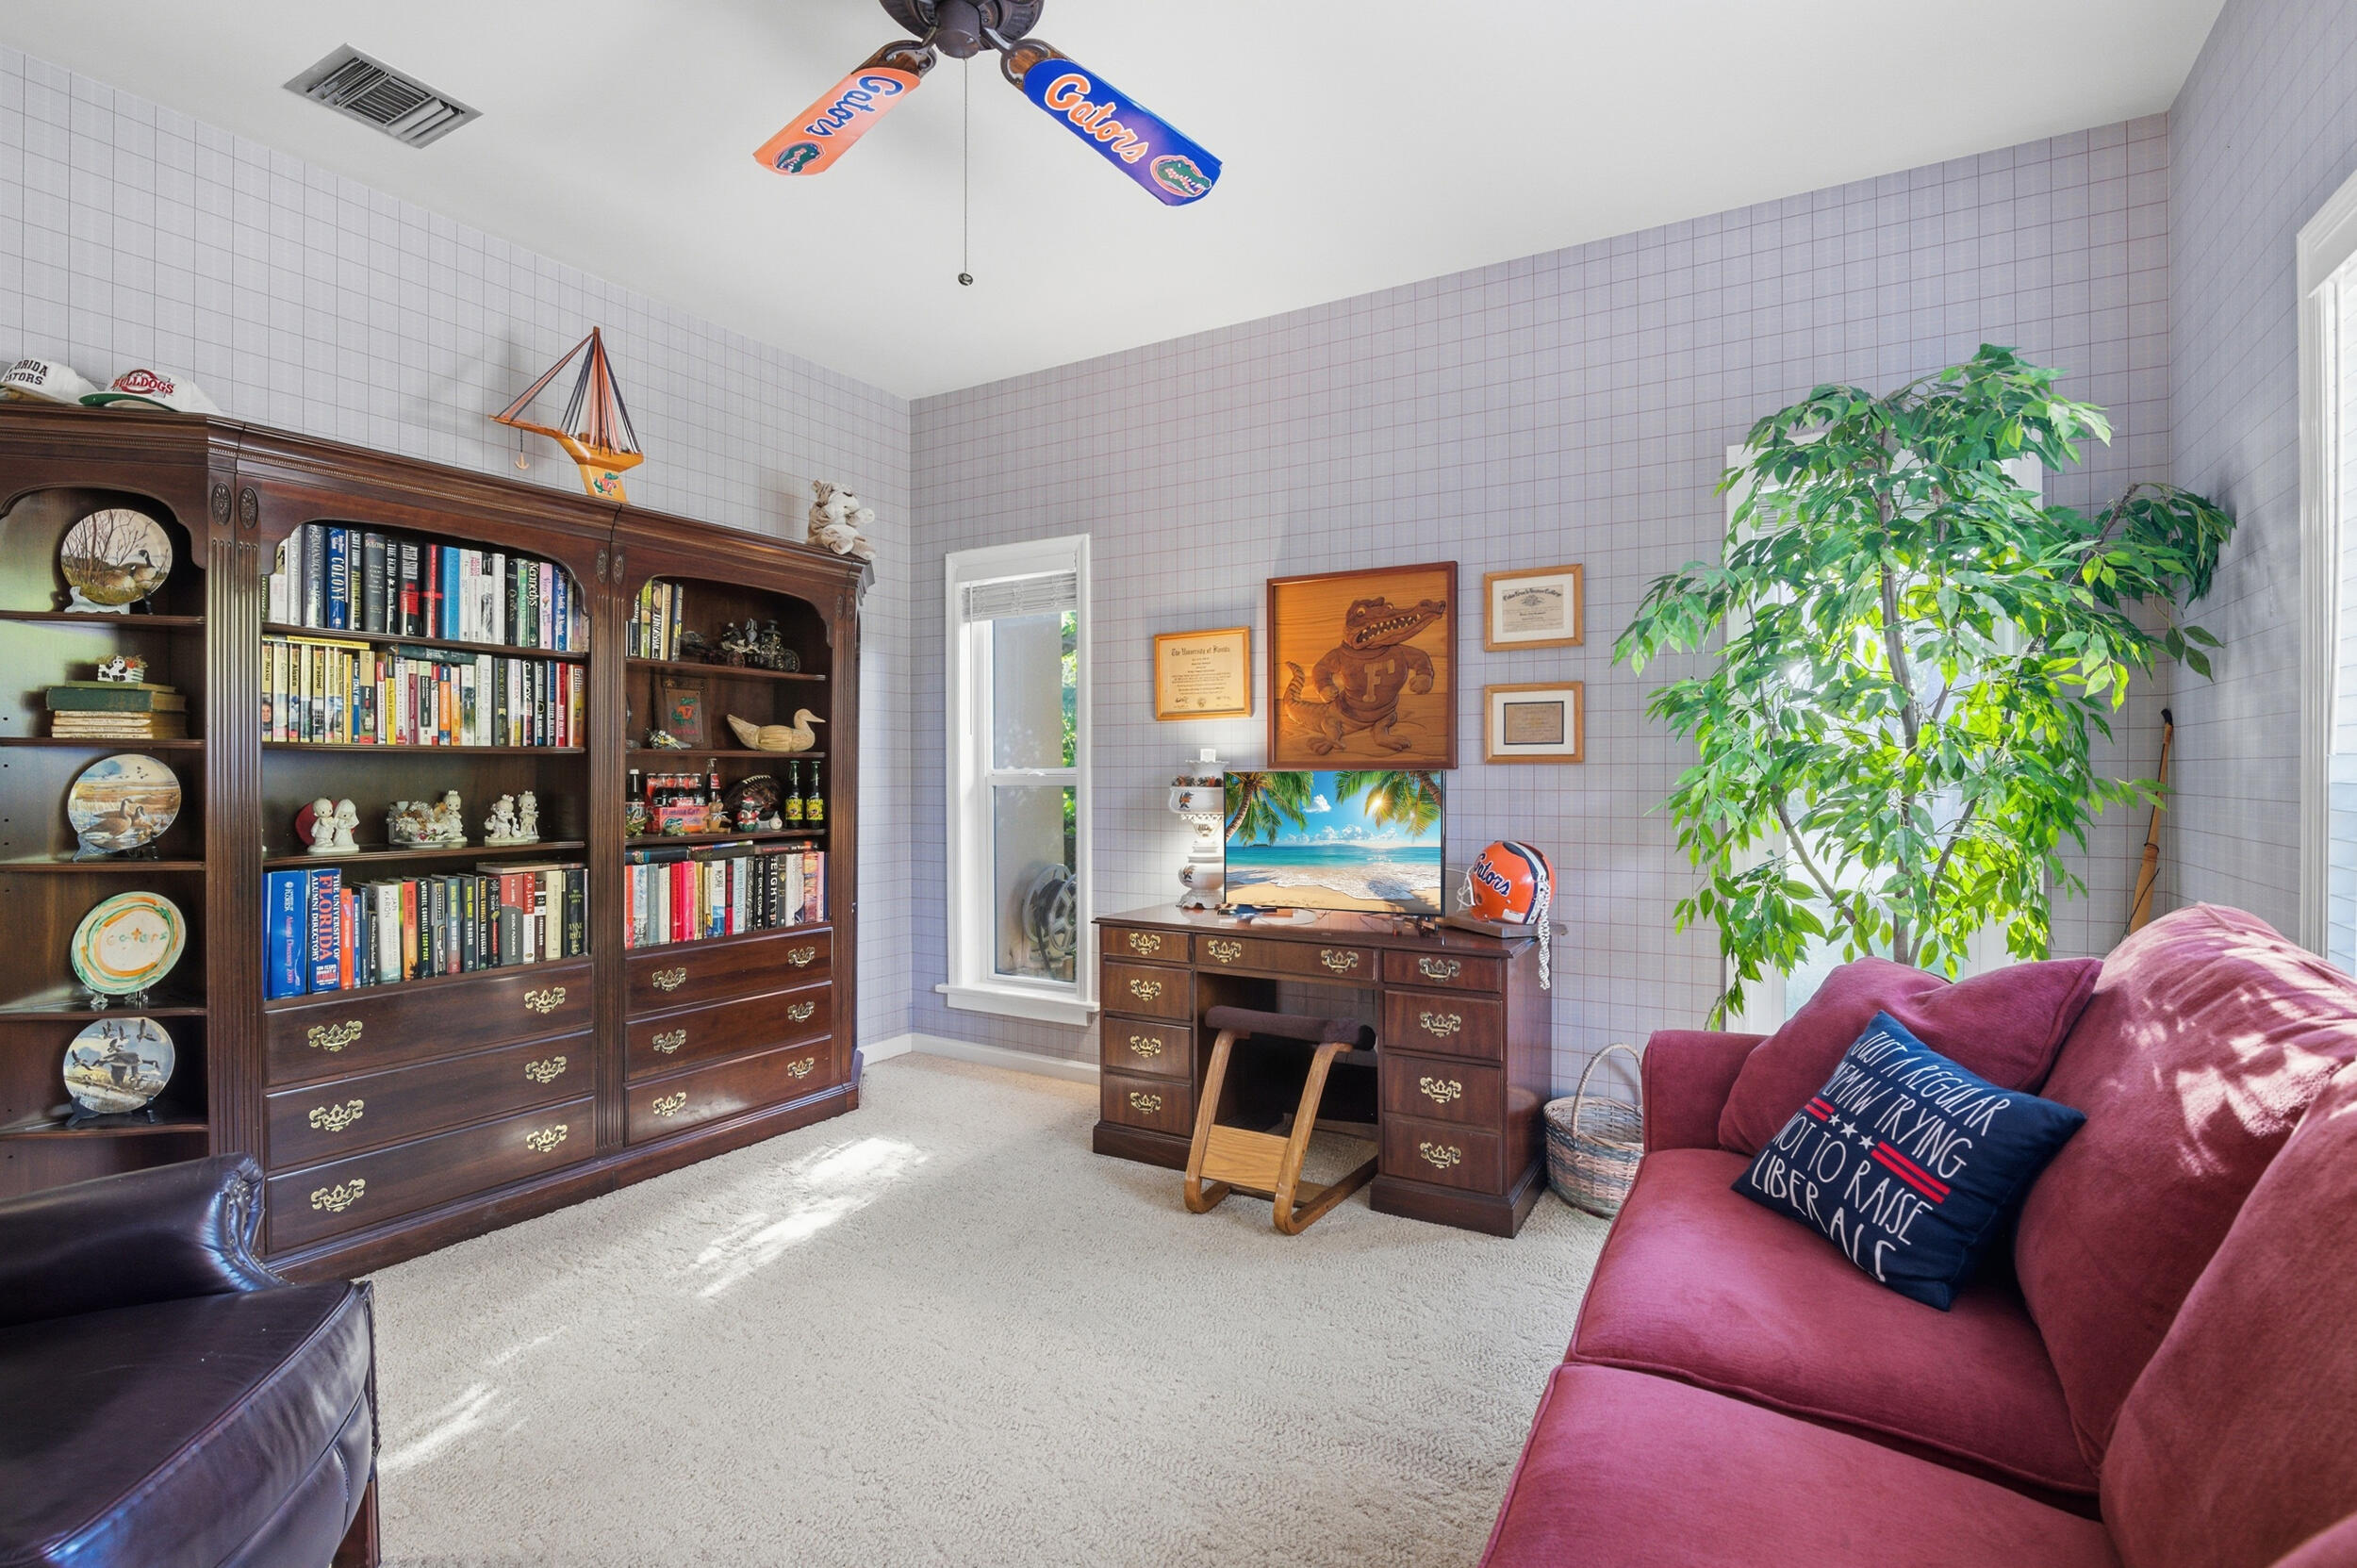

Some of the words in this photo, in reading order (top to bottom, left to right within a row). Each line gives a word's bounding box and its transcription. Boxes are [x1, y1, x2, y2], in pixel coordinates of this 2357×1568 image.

[805, 74, 906, 138] Gators
[1044, 73, 1151, 165] Gators
[111, 376, 174, 394] BULLDOGS
[331, 557, 345, 602] COLONY
[387, 557, 396, 576] ECHO
[526, 564, 539, 606] Kennedys
[1181, 647, 1206, 656] University
[1362, 658, 1395, 702] F
[1473, 852, 1511, 897] Gators
[319, 875, 333, 961] FLORIDA
[420, 907, 429, 932] CONNELLY
[333, 949, 340, 960] OF
[1850, 1031, 1907, 1069] JUST
[1881, 1055, 1911, 1076] A
[1898, 1064, 2011, 1136] REGULAR
[1824, 1062, 1887, 1115] MEMAW
[1873, 1093, 1974, 1180] TRYING
[1772, 1111, 1817, 1160] NOT
[1807, 1131, 1846, 1183] TO
[1844, 1159, 1933, 1246] RAISE
